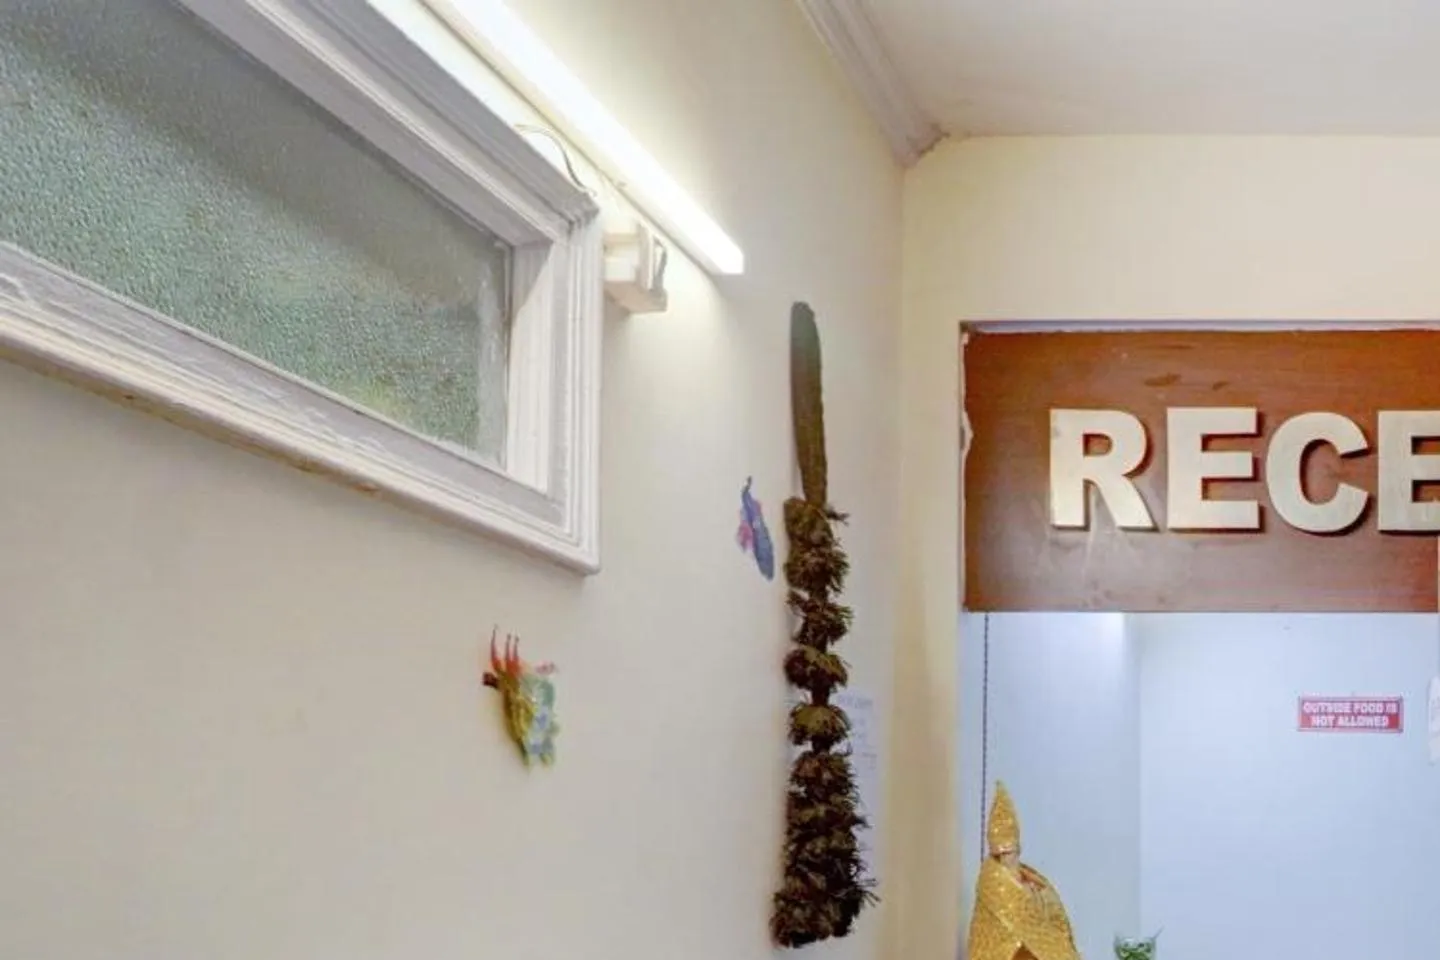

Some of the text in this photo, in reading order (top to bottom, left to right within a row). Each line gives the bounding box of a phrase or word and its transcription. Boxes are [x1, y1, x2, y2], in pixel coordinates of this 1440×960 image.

[1303, 702, 1351, 713] OUTSIDE
[1353, 702, 1384, 713] FOOD
[1311, 715, 1388, 727] NOT ALLOWED
